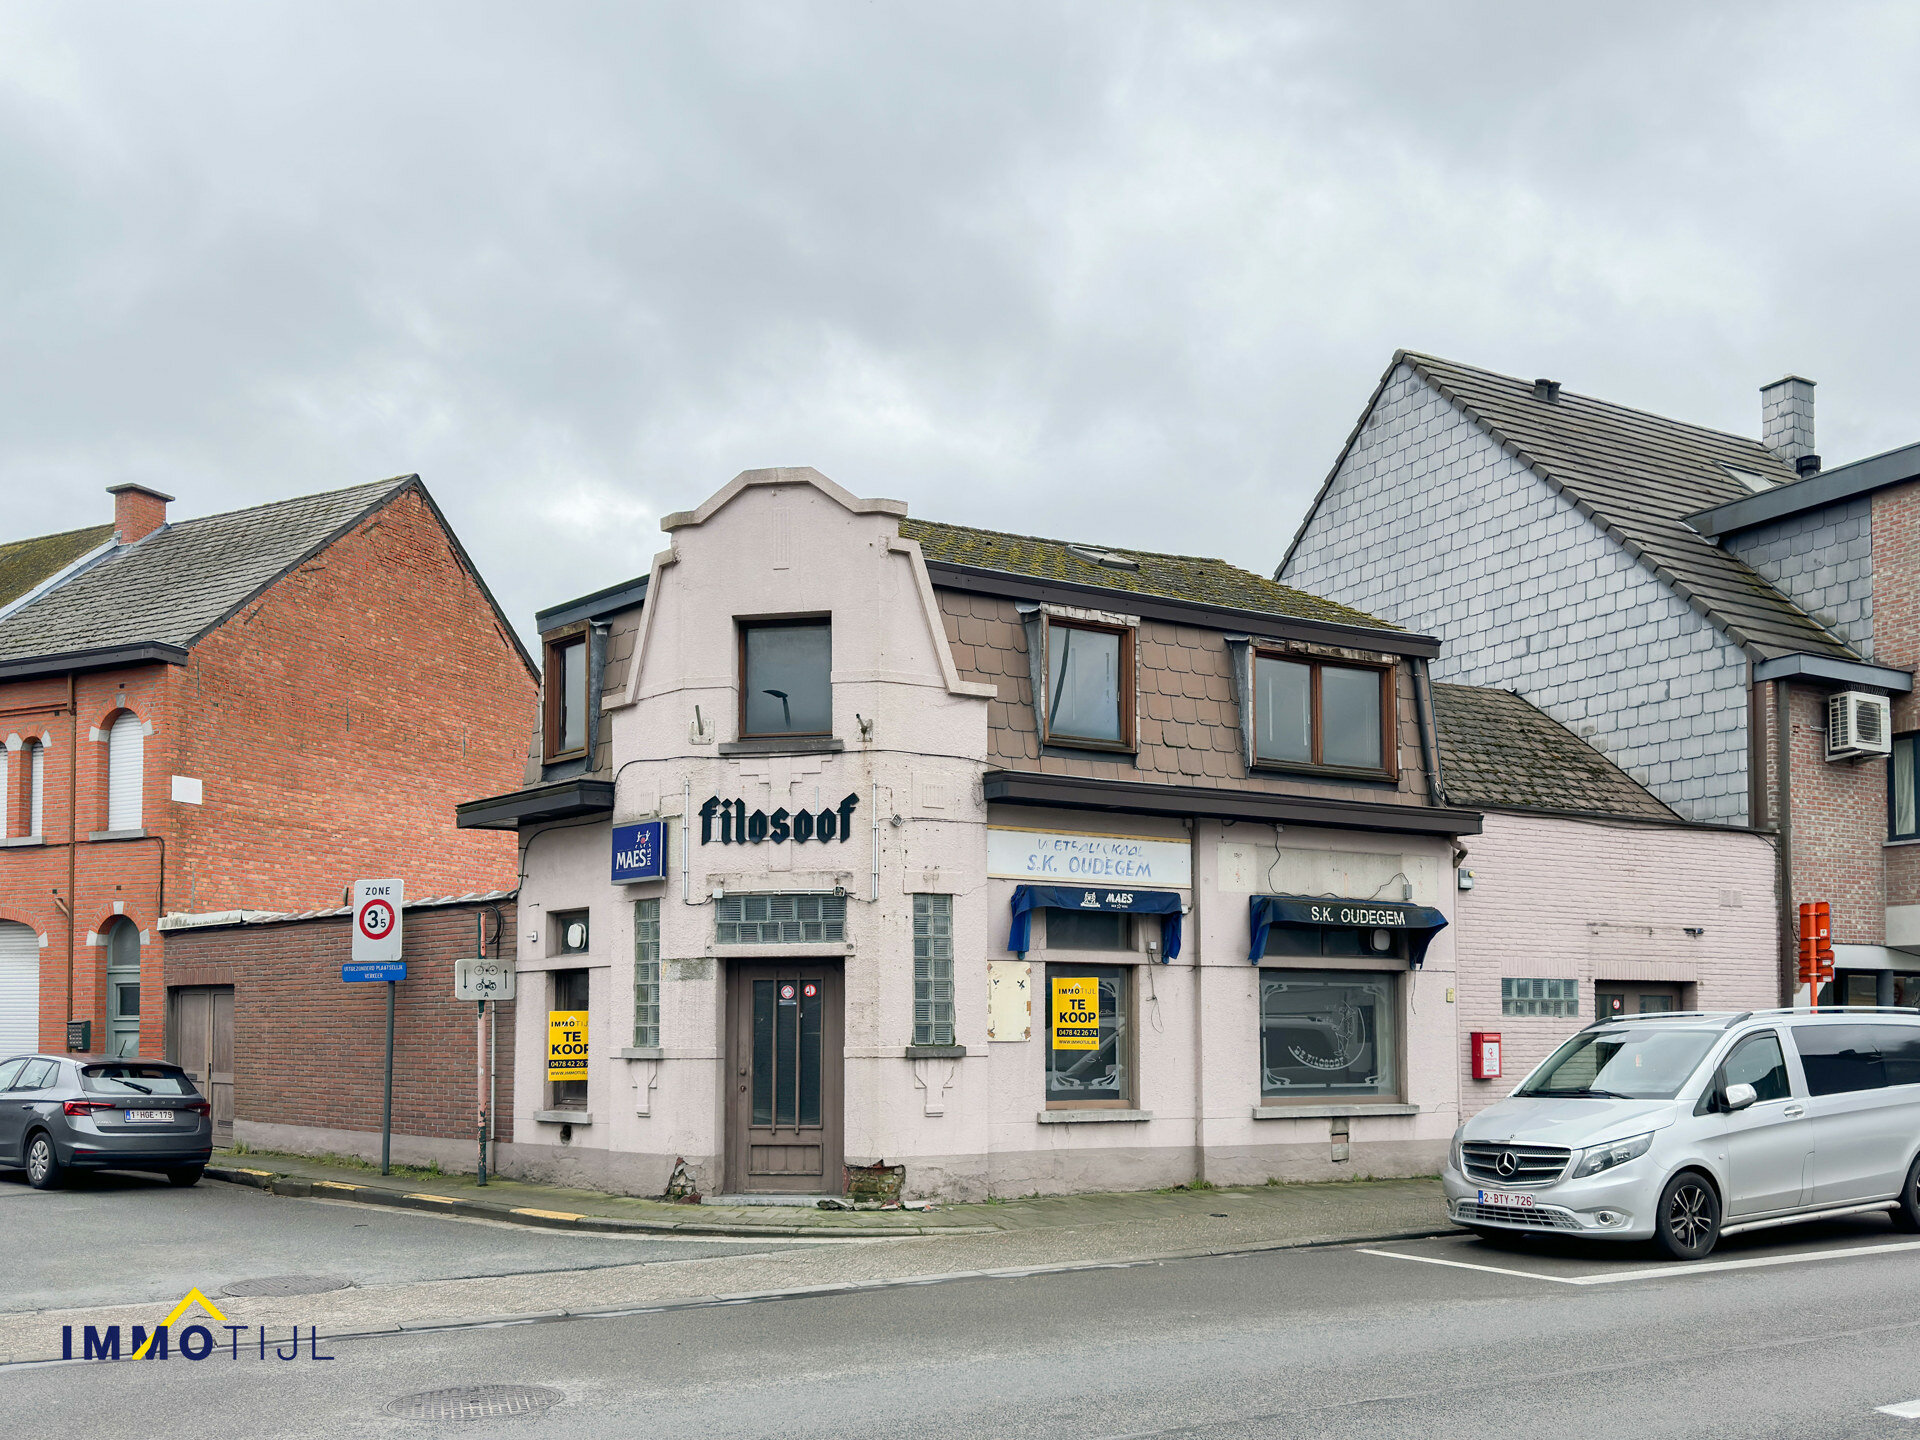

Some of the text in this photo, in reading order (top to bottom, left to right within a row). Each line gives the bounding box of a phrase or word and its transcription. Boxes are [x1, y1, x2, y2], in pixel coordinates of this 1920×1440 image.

[698, 792, 860, 846] filosoof
[616, 849, 647, 870] MAES
[1027, 854, 1152, 878] S.K. OUDEGEM
[365, 886, 391, 896] ZONE
[1105, 892, 1134, 904] MAES
[1311, 906, 1406, 926] S.K. OUDEGEM
[1069, 999, 1086, 1010] TE
[1059, 1012, 1097, 1023] KOOP
[563, 1031, 582, 1042] TE
[550, 1060, 566, 1068] 0478
[1483, 1192, 1532, 1207] 2-BTY-726
